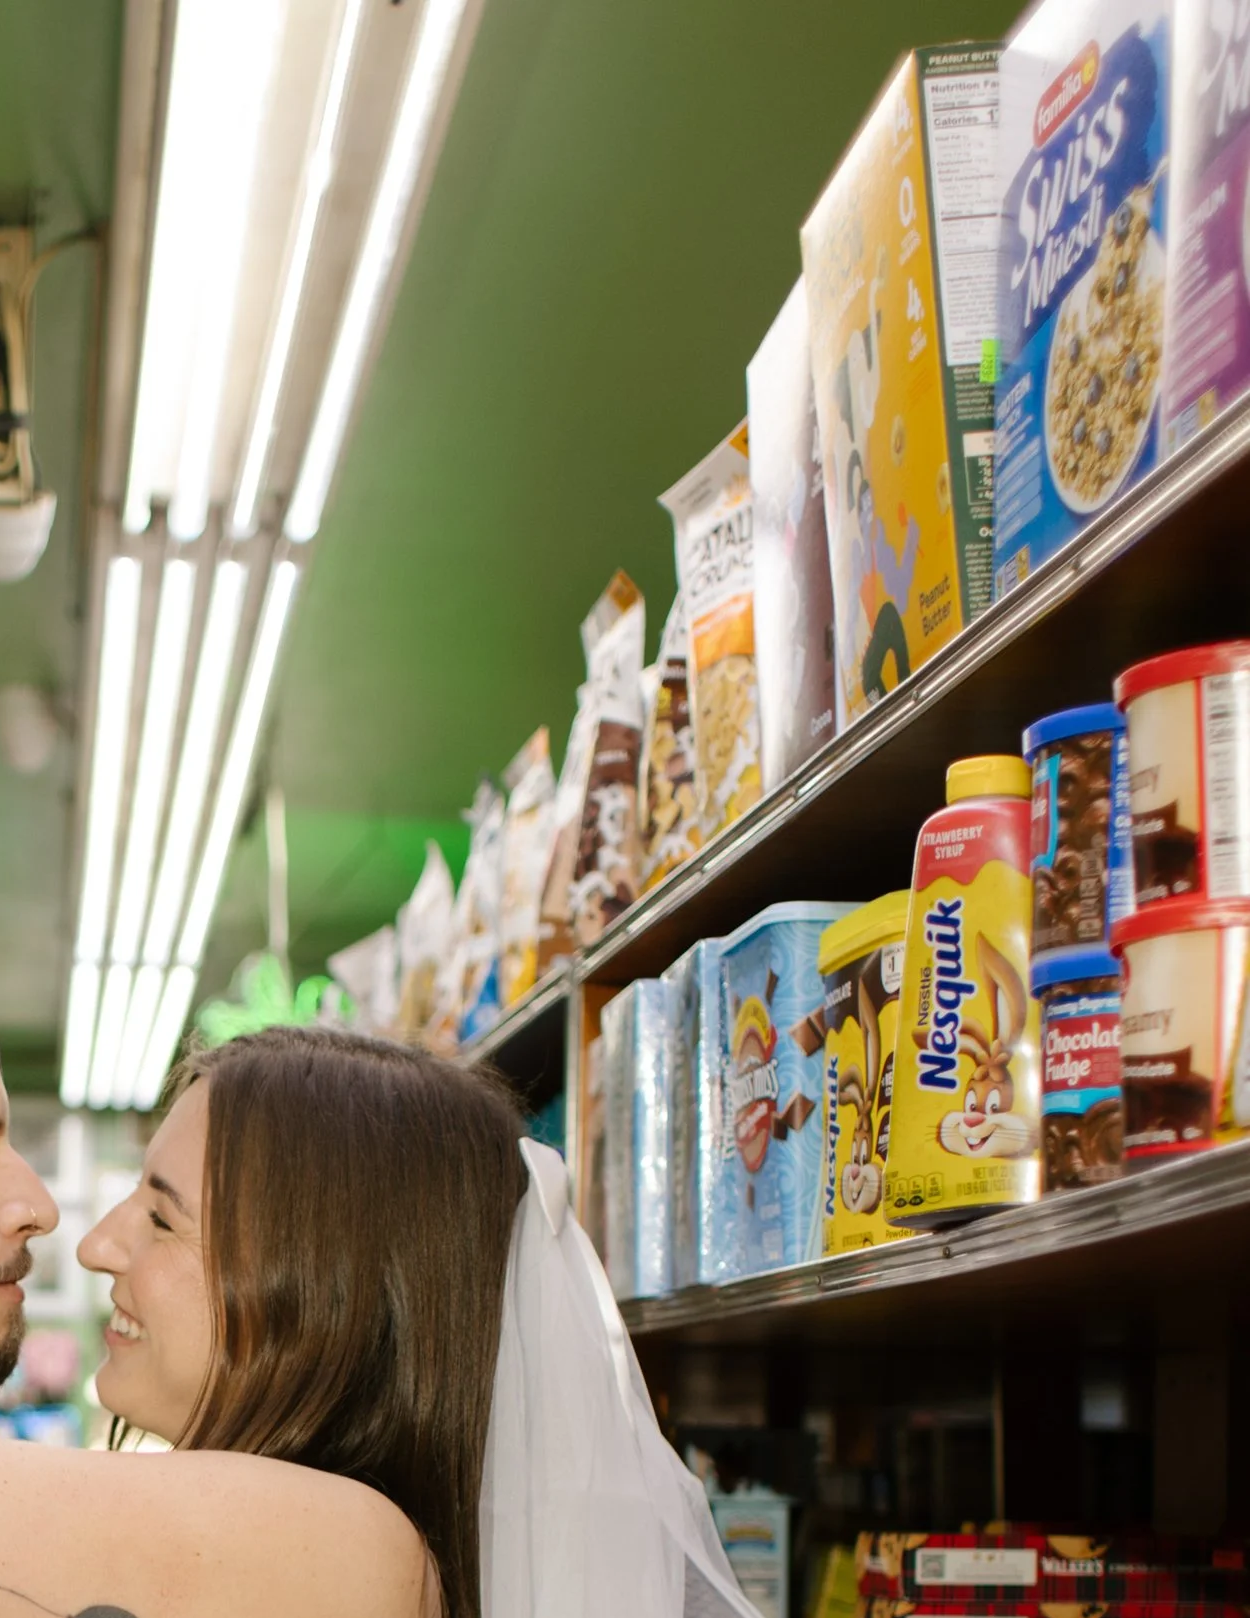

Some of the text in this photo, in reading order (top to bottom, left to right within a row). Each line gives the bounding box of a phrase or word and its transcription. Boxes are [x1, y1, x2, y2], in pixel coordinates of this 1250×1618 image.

[928, 51, 1000, 66] PEANUT BUTT
[931, 82, 980, 93] Nutrition
[1037, 67, 1081, 134] familia
[934, 115, 979, 126] Calories
[1011, 78, 1128, 290] Swiss
[919, 576, 950, 607] Peanut
[922, 600, 952, 637] Butter
[811, 709, 833, 737] Cocoa
[922, 824, 984, 846] STRAWBERRY
[935, 844, 966, 860] SYRUP
[918, 898, 976, 1093] Nesquik
[1046, 1022, 1122, 1056] Chocolat
[1046, 1054, 1092, 1086] Fudge
[825, 1055, 841, 1217] Nesquik
[1041, 1555, 1104, 1576] WALKER'S
